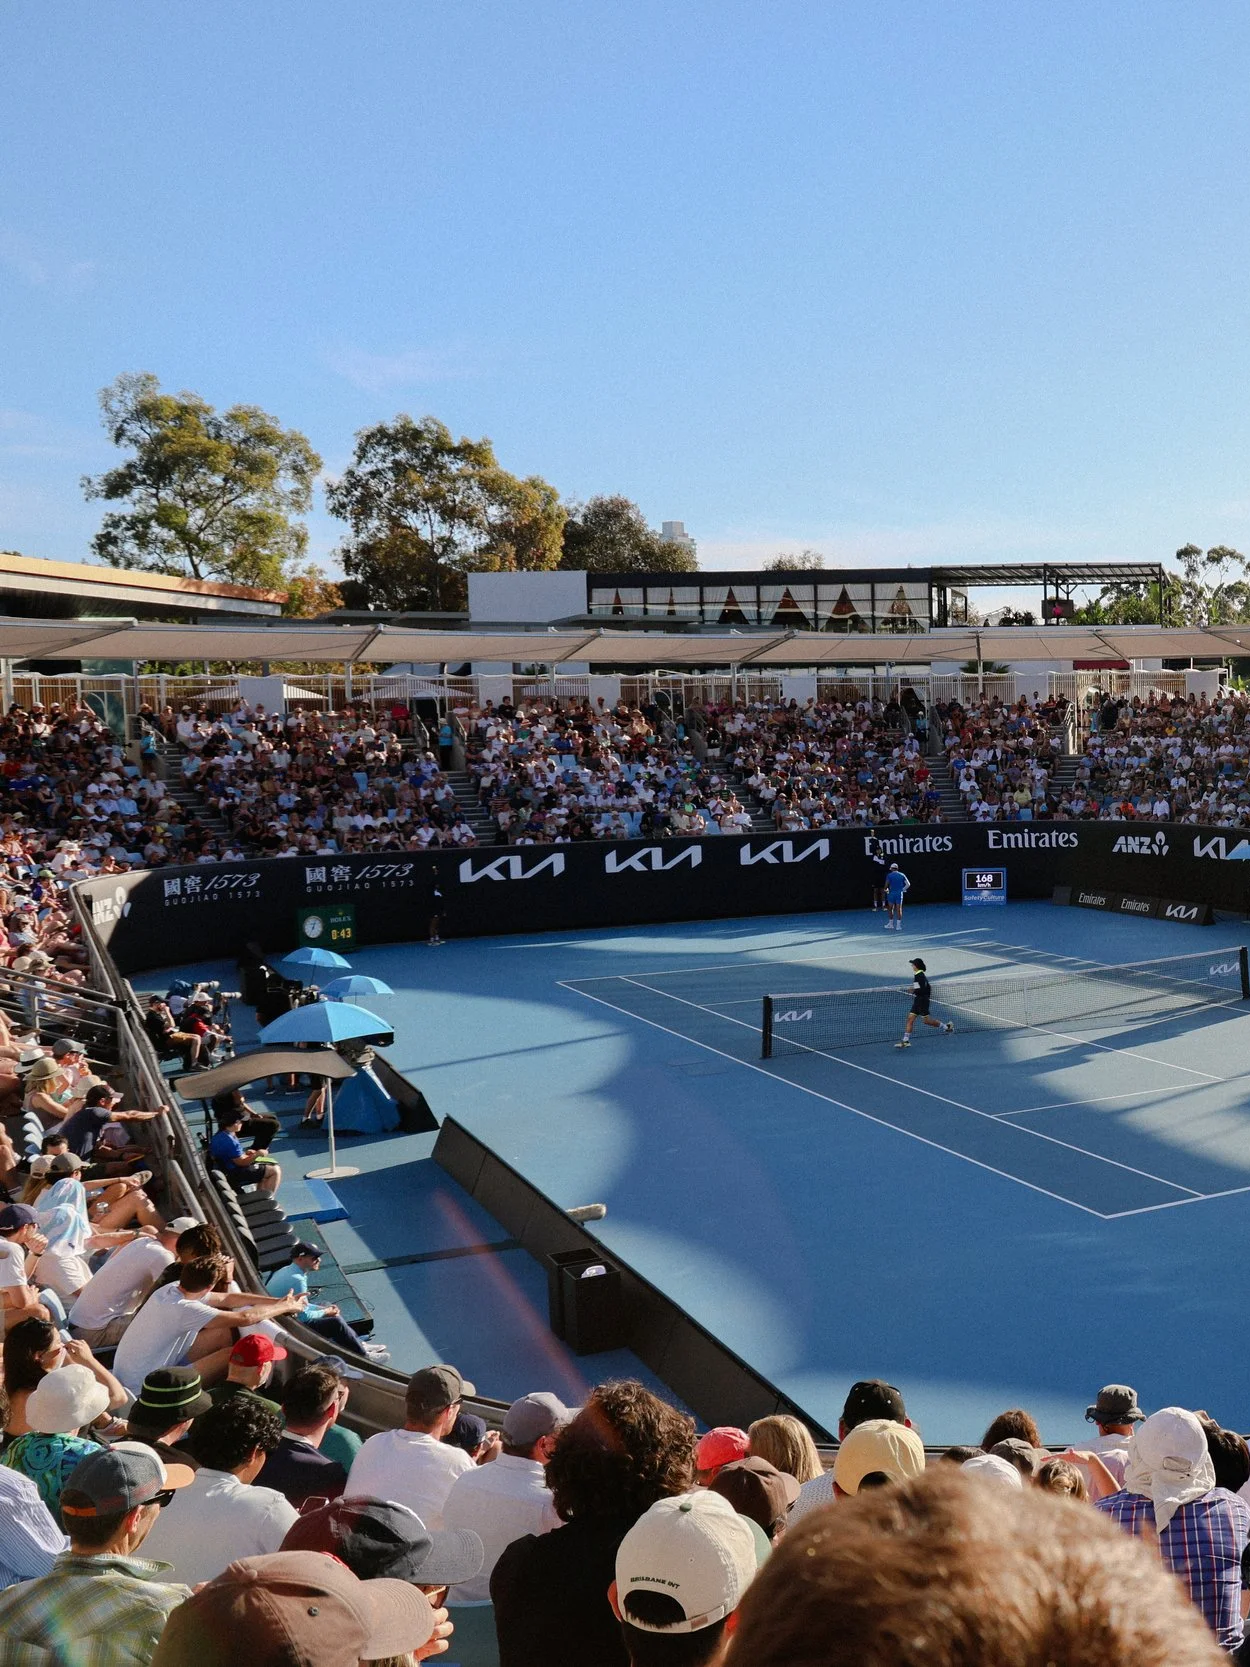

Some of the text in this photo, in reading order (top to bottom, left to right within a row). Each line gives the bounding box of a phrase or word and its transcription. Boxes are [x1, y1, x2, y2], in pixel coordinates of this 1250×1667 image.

[987, 829, 1079, 849] Emirates
[1112, 836, 1151, 855] ANZ
[605, 845, 702, 873] KIA
[740, 838, 830, 866] KIA
[459, 852, 566, 883] KIA
[976, 874, 993, 883] 168
[306, 880, 414, 893] GUOJIAO 1573
[164, 890, 261, 907] GUOJIAO 1573
[1078, 892, 1106, 906] Emirates
[1120, 898, 1150, 912] Emirates
[1165, 904, 1199, 920] KIA
[1210, 962, 1241, 976] KIA
[774, 1009, 813, 1023] KIA
[630, 1576, 680, 1590] BRISBANE INT
